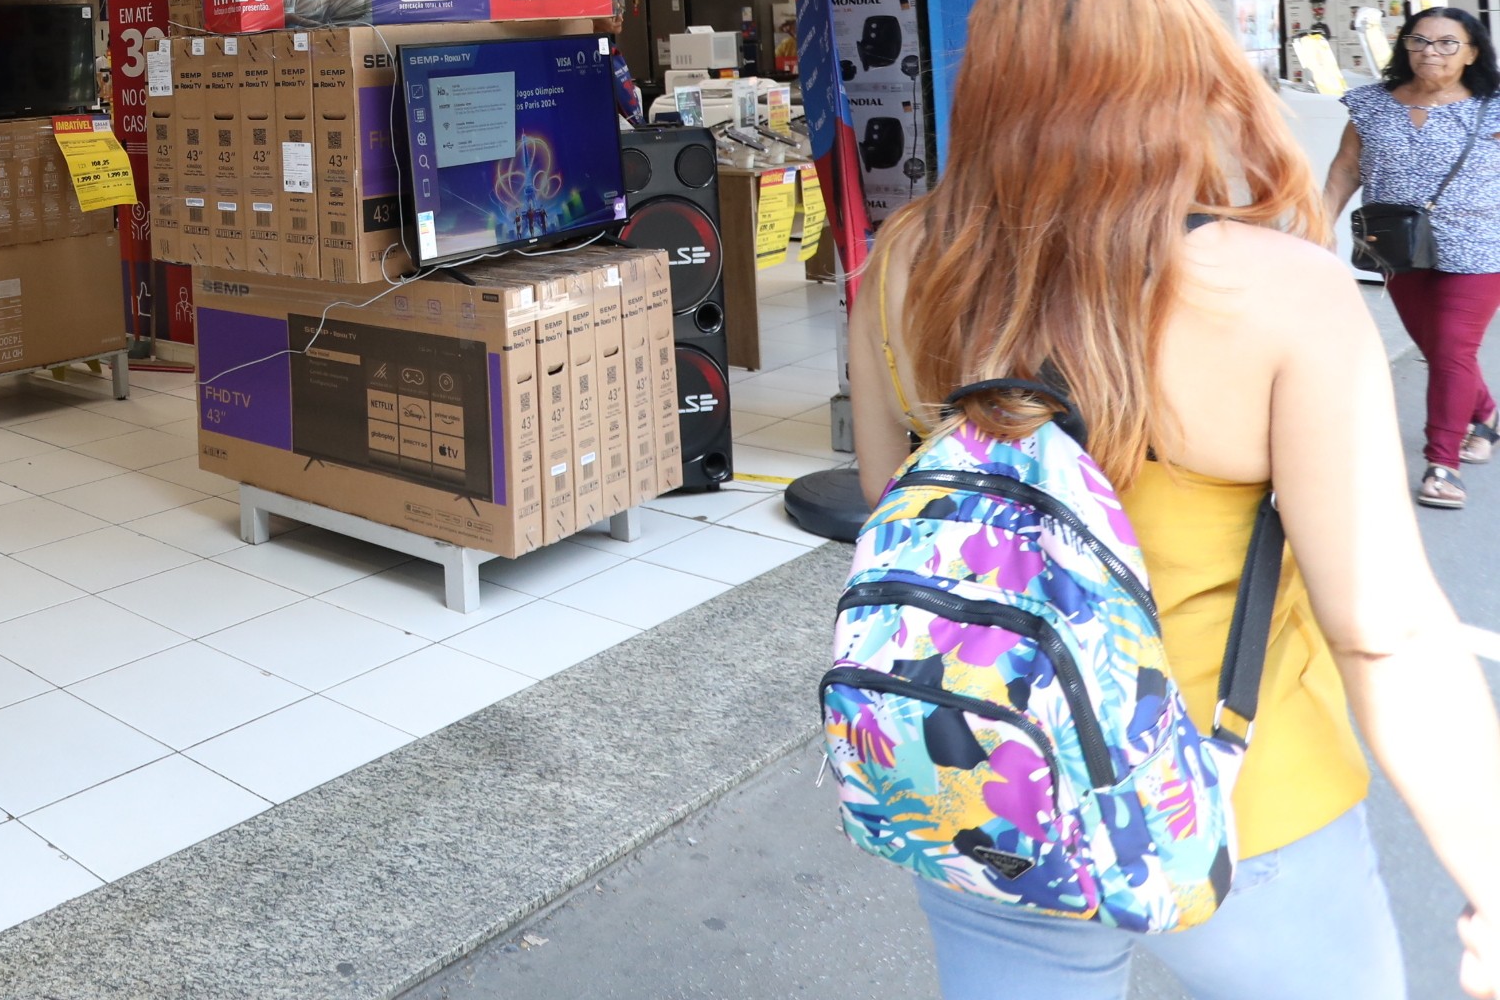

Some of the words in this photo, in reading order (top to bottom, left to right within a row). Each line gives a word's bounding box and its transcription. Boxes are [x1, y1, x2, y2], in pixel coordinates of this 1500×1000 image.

[119, 8, 134, 26] EM
[135, 3, 153, 24] ATÉ
[409, 56, 439, 65] SEMP
[462, 53, 471, 62] TV
[556, 57, 571, 67] VISA
[535, 86, 564, 97] Olímpicos
[121, 89, 137, 107] NO
[525, 100, 540, 109] Paris
[541, 98, 557, 108] 2024.
[55, 119, 92, 131] IMBATÍVEL
[202, 280, 250, 296] SEMP
[652, 287, 668, 298] SEMP
[370, 399, 394, 413] NETFLIX
[370, 430, 396, 442] globoplay
